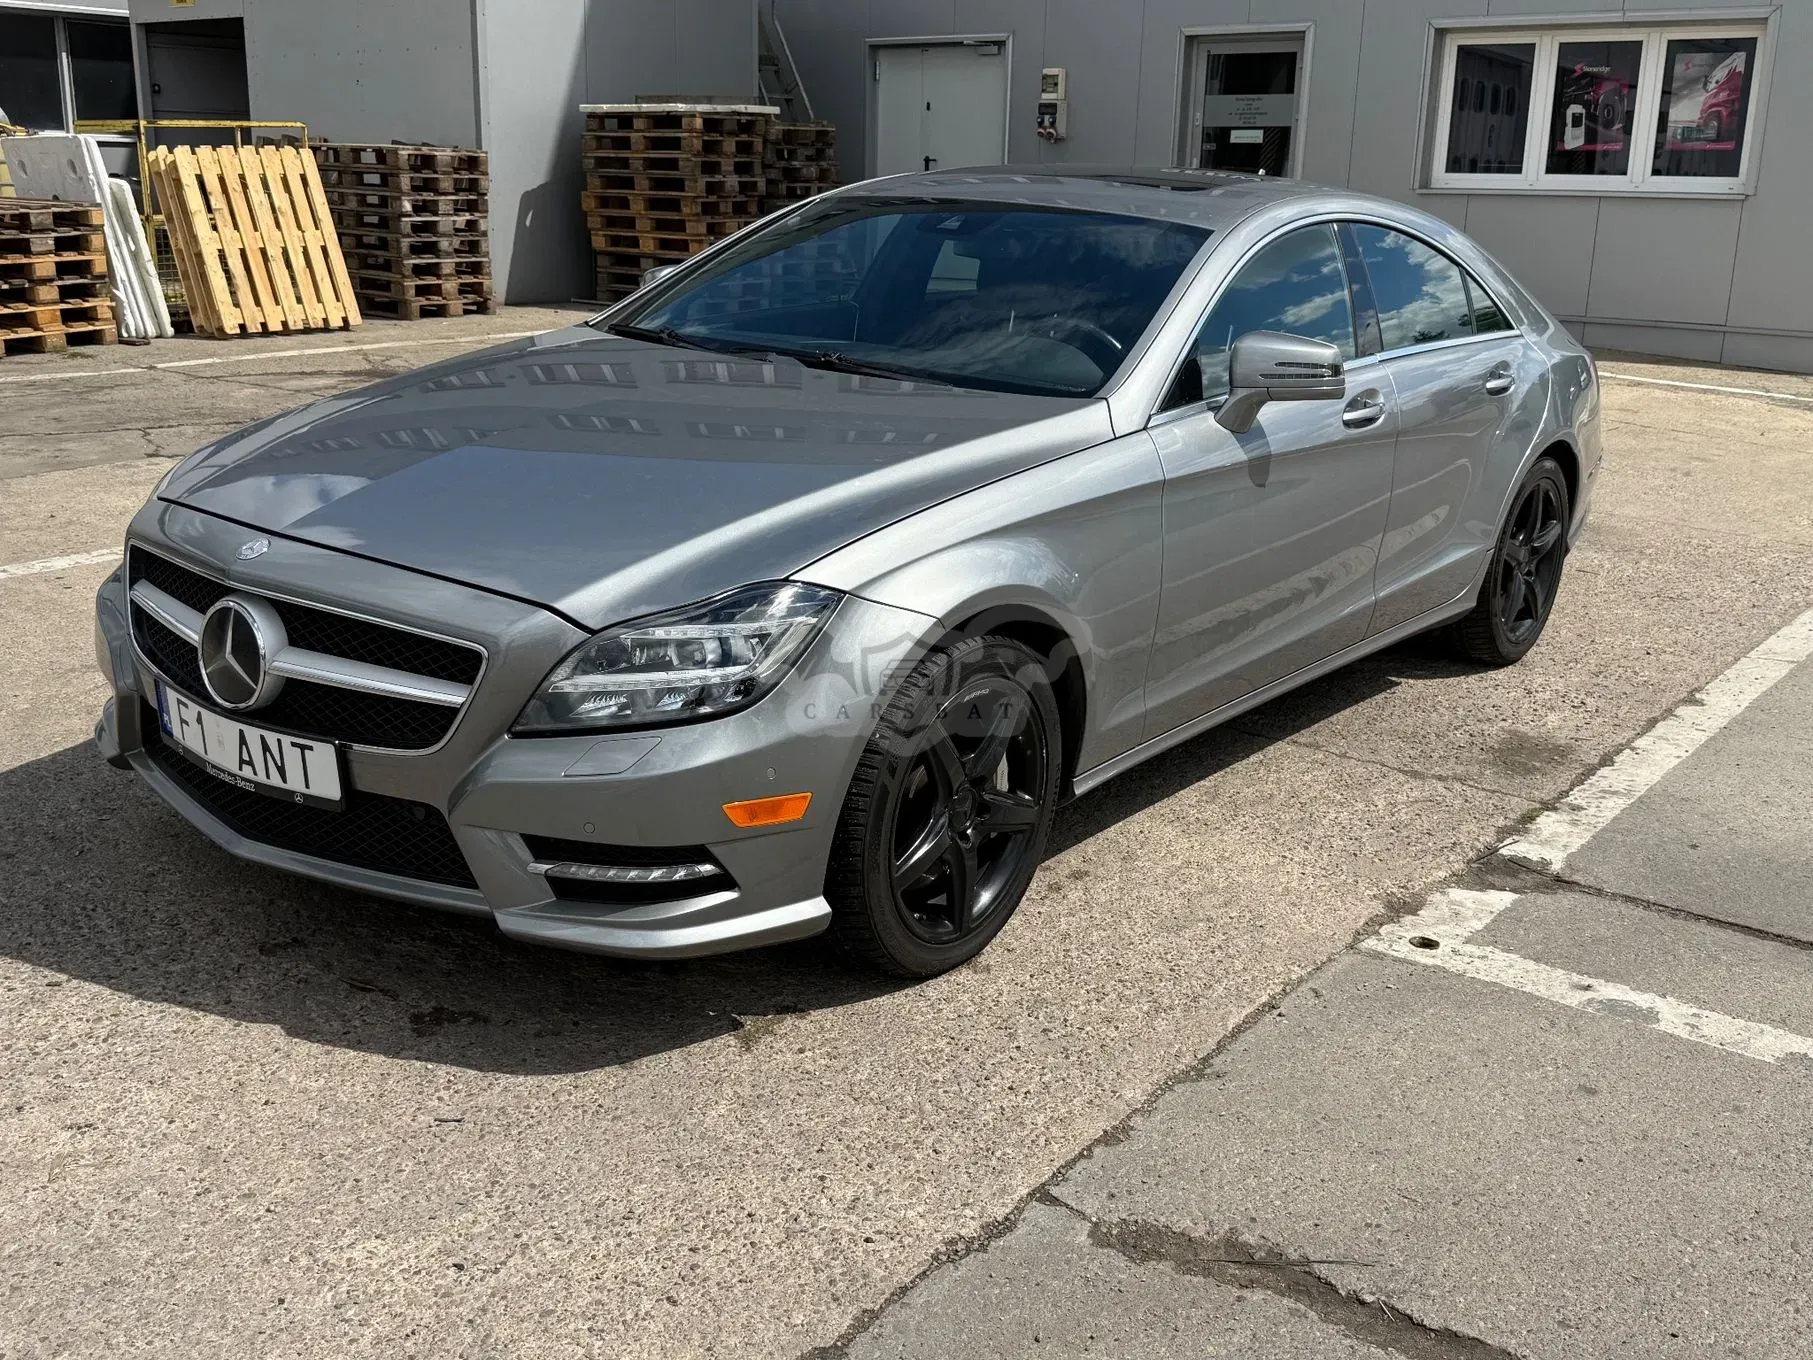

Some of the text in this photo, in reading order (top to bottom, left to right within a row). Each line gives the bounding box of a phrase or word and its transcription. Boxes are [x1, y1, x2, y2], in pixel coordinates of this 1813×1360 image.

[176, 697, 314, 790] F1 ANT
[205, 761, 256, 792] Mercedes-Benz
